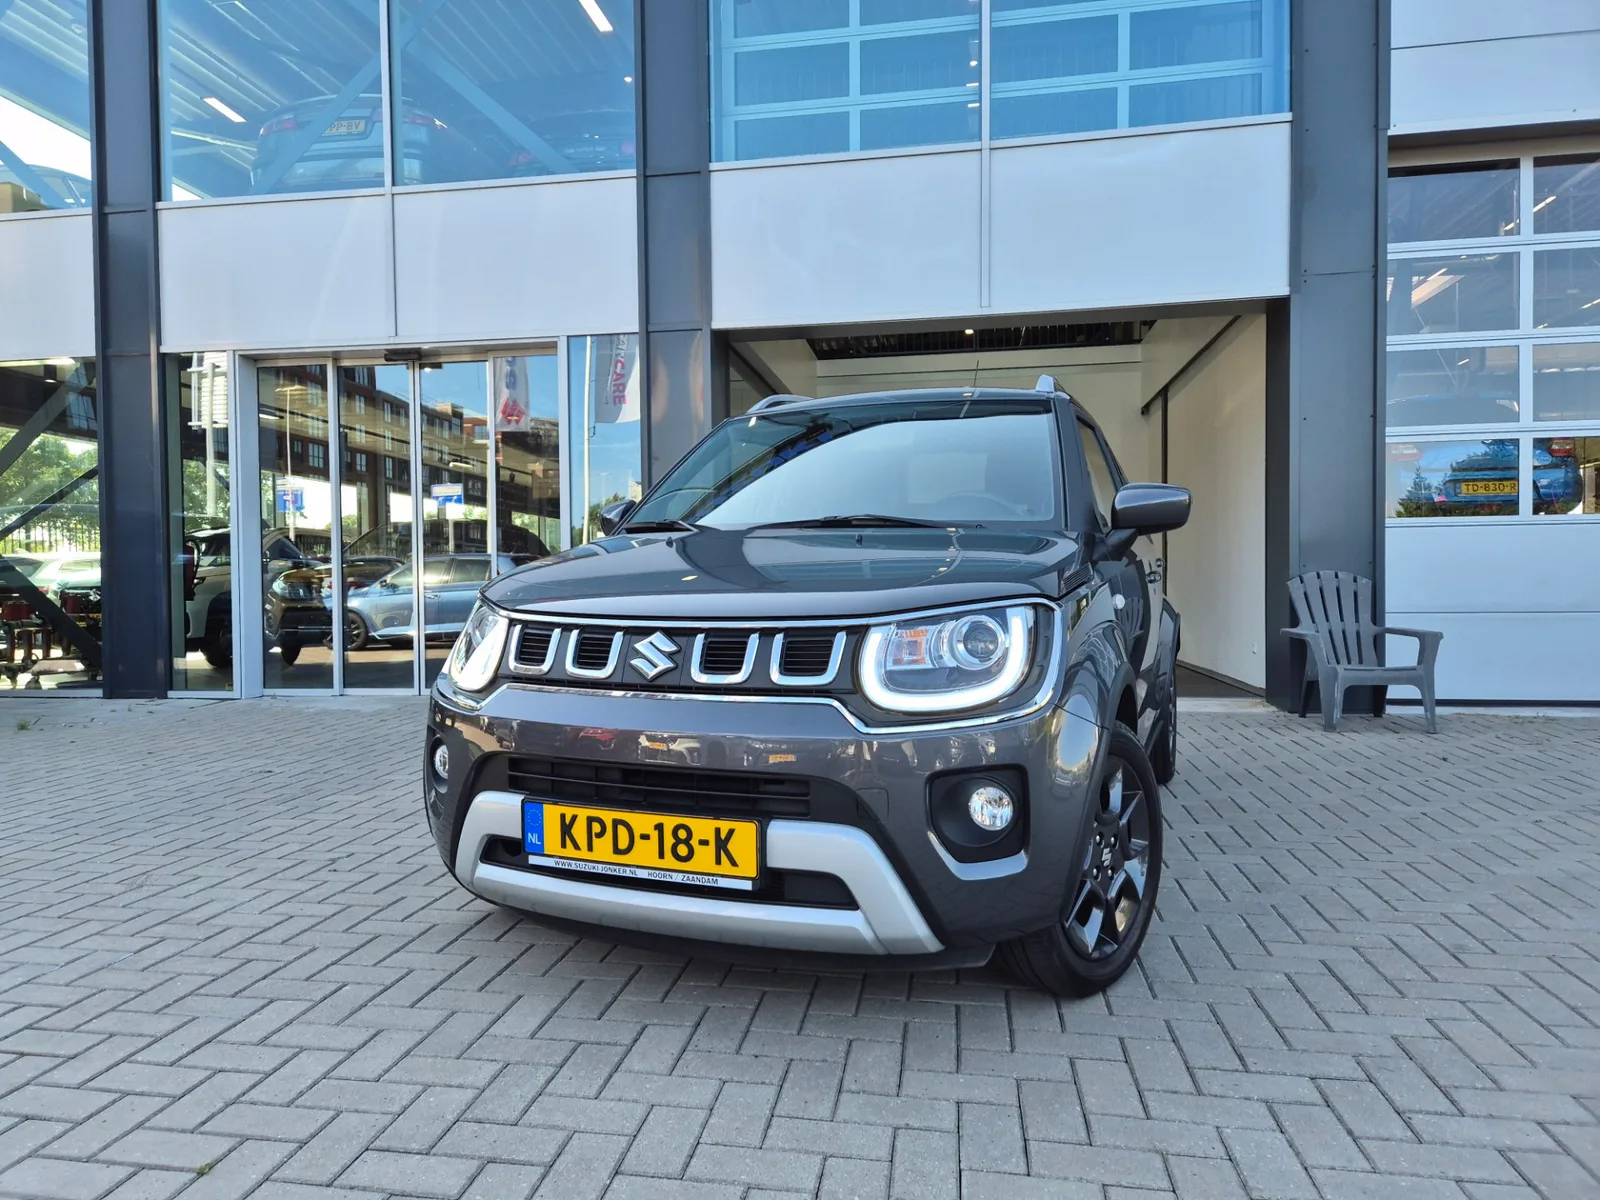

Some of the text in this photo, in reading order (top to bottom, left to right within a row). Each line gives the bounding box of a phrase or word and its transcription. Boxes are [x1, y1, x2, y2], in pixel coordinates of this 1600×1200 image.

[329, 121, 361, 132] PP-BV
[1464, 482, 1517, 492] TD-830-R
[527, 832, 542, 845] NL
[559, 812, 739, 868] KPD-18-K
[647, 871, 673, 881] HOORN
[681, 875, 719, 886] ZAANDAM
